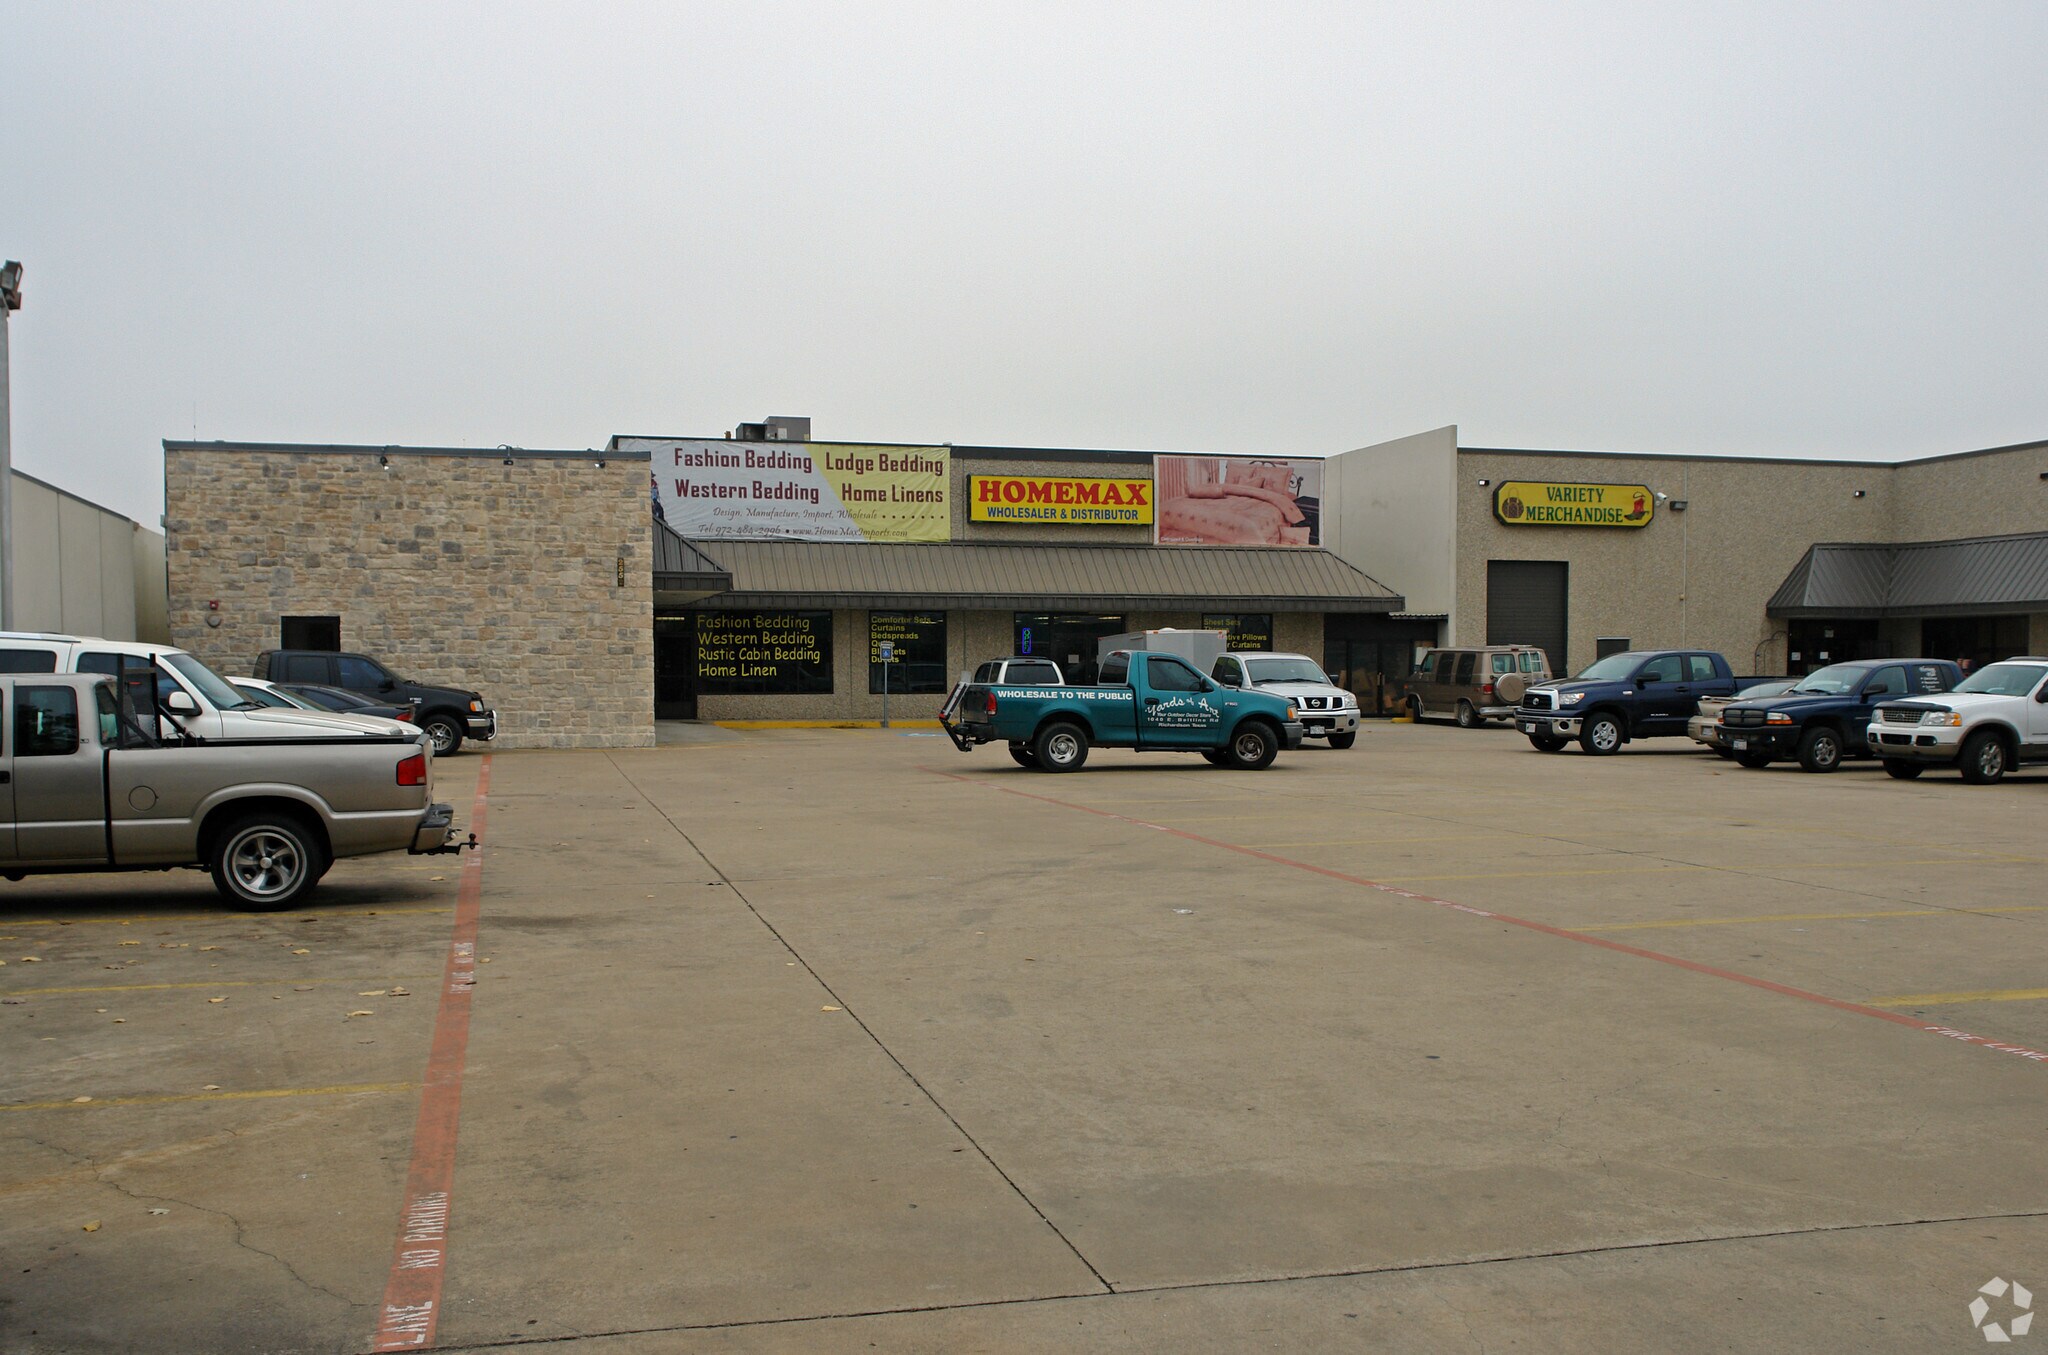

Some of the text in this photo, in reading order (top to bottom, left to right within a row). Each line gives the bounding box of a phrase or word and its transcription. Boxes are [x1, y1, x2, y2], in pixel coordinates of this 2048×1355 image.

[674, 447, 812, 474] Fashion Bedding
[825, 451, 944, 477] Lodge Bedding
[675, 478, 820, 505] Western Bedding
[841, 482, 944, 503] Home Linens
[977, 479, 1148, 506] HOMEMAX
[1545, 486, 1605, 503] VARIETY
[713, 507, 878, 523] Design, Manufacture, Import, Wholesale
[987, 506, 1139, 521] WHOLESALER & DISTRIBUTOR
[1525, 505, 1623, 523] MERCHANDISE
[697, 614, 810, 632] Fashion Bedding
[871, 616, 932, 624] Comforter Sets
[871, 624, 906, 632] Curtains
[697, 630, 815, 648] Western Bedding
[871, 632, 919, 640] Bedspreads
[1241, 633, 1267, 641] Pillows
[698, 647, 820, 664] Rustic Cabin Bedding
[698, 663, 777, 677] Home Linen
[997, 690, 1133, 700] WHOLESALE TO THE PUBLIC
[379, 1191, 449, 1347] LANE NO PARKING
